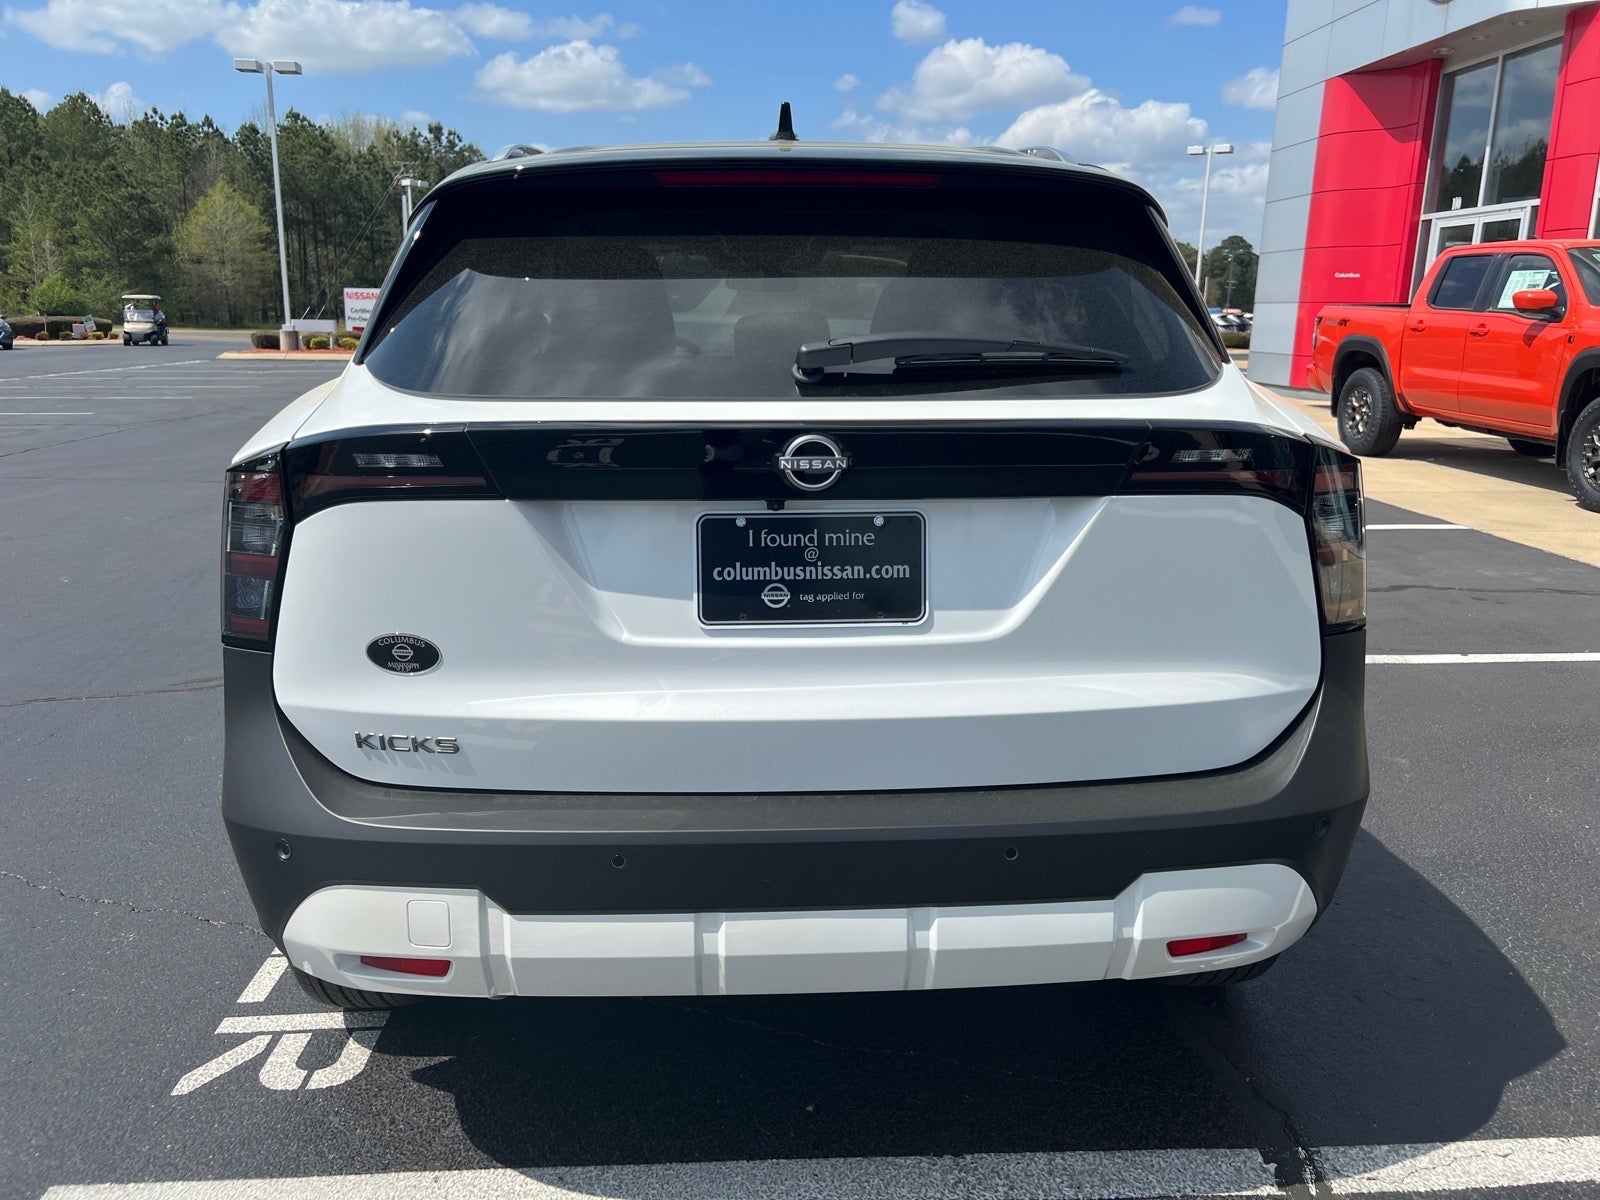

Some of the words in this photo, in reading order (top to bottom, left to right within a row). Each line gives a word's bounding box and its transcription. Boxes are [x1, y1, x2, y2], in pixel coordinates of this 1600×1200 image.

[780, 459, 847, 469] NISSAN
[748, 529, 754, 547] I
[760, 529, 818, 547] found
[825, 530, 876, 546] mine
[804, 547, 819, 562] @
[712, 561, 911, 581] columbusnissan.com
[799, 593, 815, 602] tag
[816, 591, 850, 602] applied
[852, 591, 865, 600] for
[378, 636, 426, 648] COLUMBUS
[354, 731, 460, 754] KICKS
